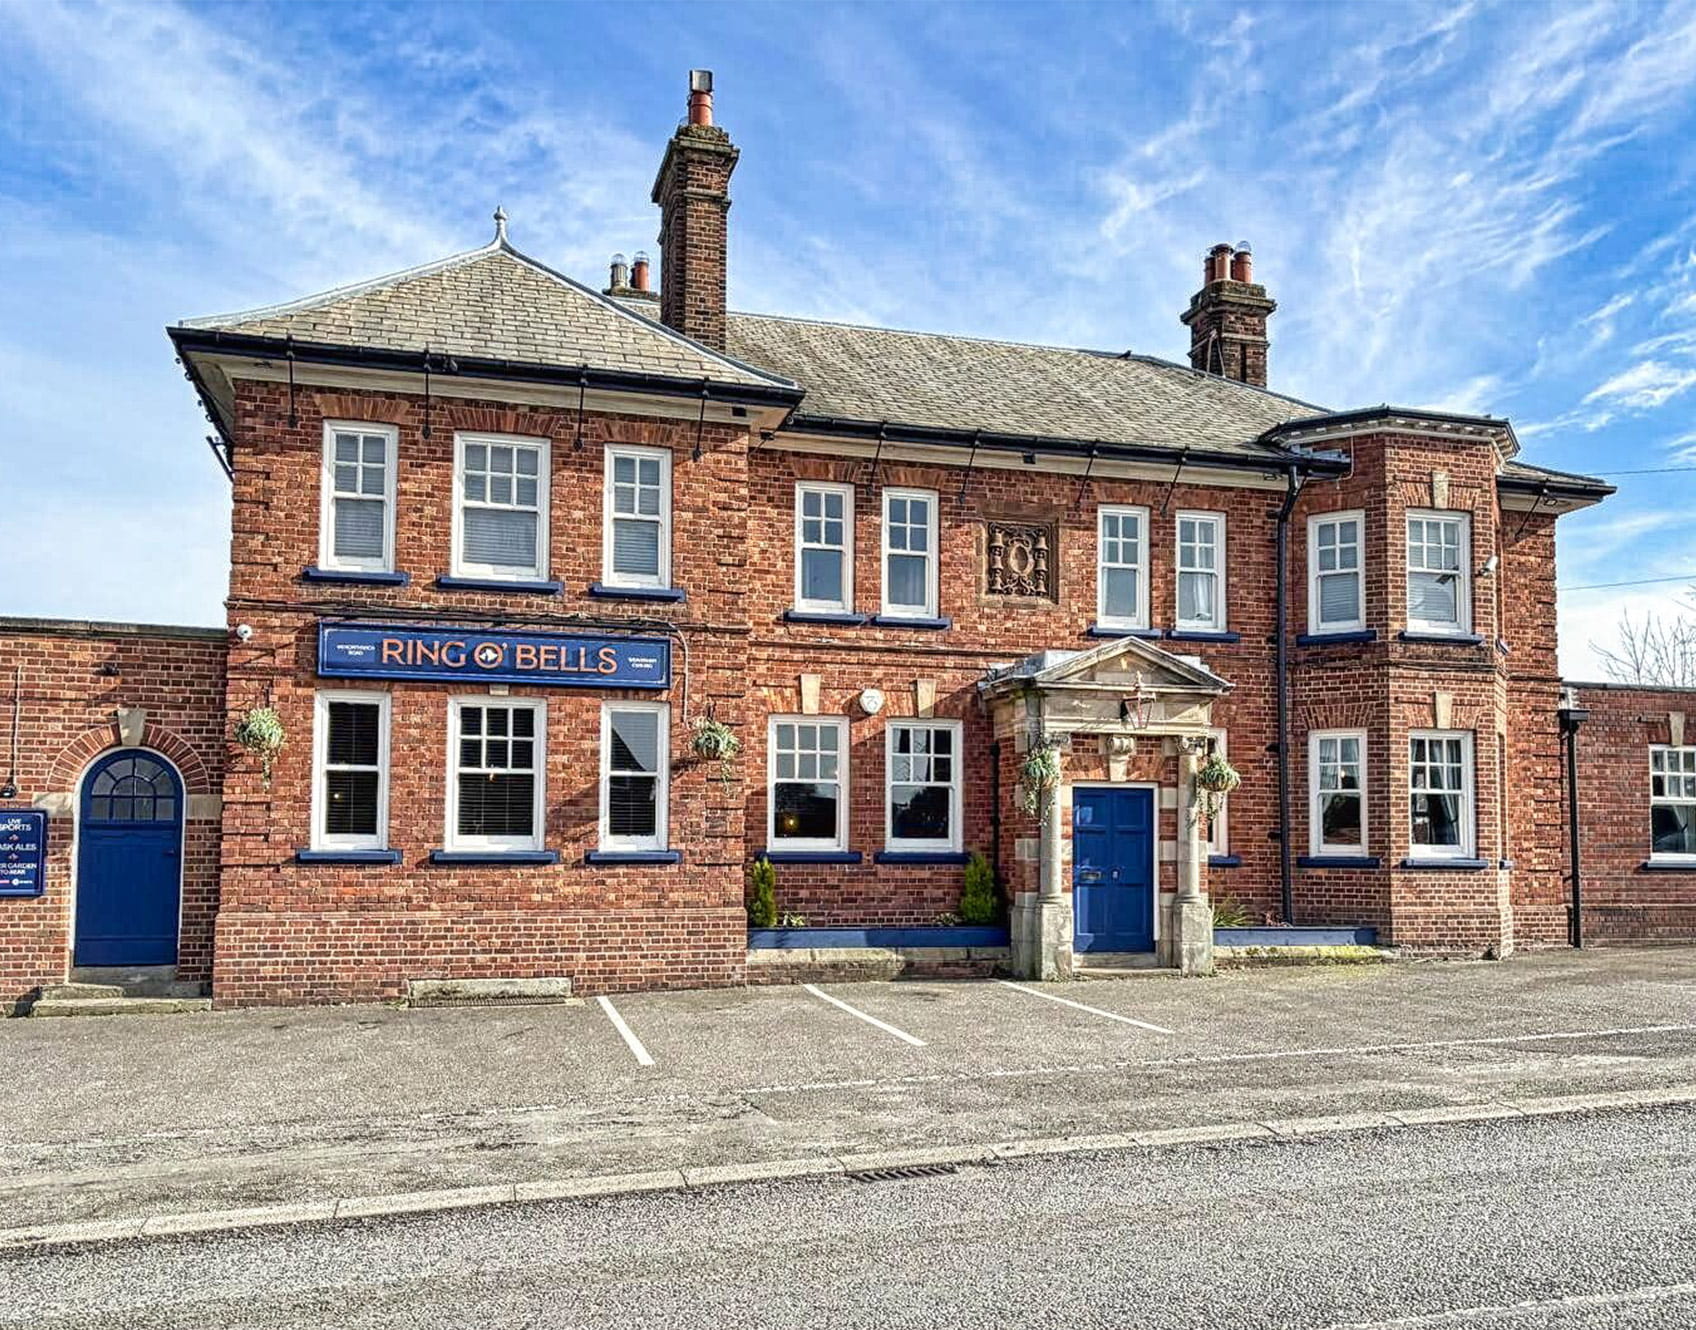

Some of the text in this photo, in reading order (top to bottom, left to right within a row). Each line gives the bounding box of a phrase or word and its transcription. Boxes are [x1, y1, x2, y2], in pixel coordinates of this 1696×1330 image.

[382, 638, 466, 668] RING
[516, 643, 618, 674] BELLS
[0, 843, 37, 851] ASK ALES
